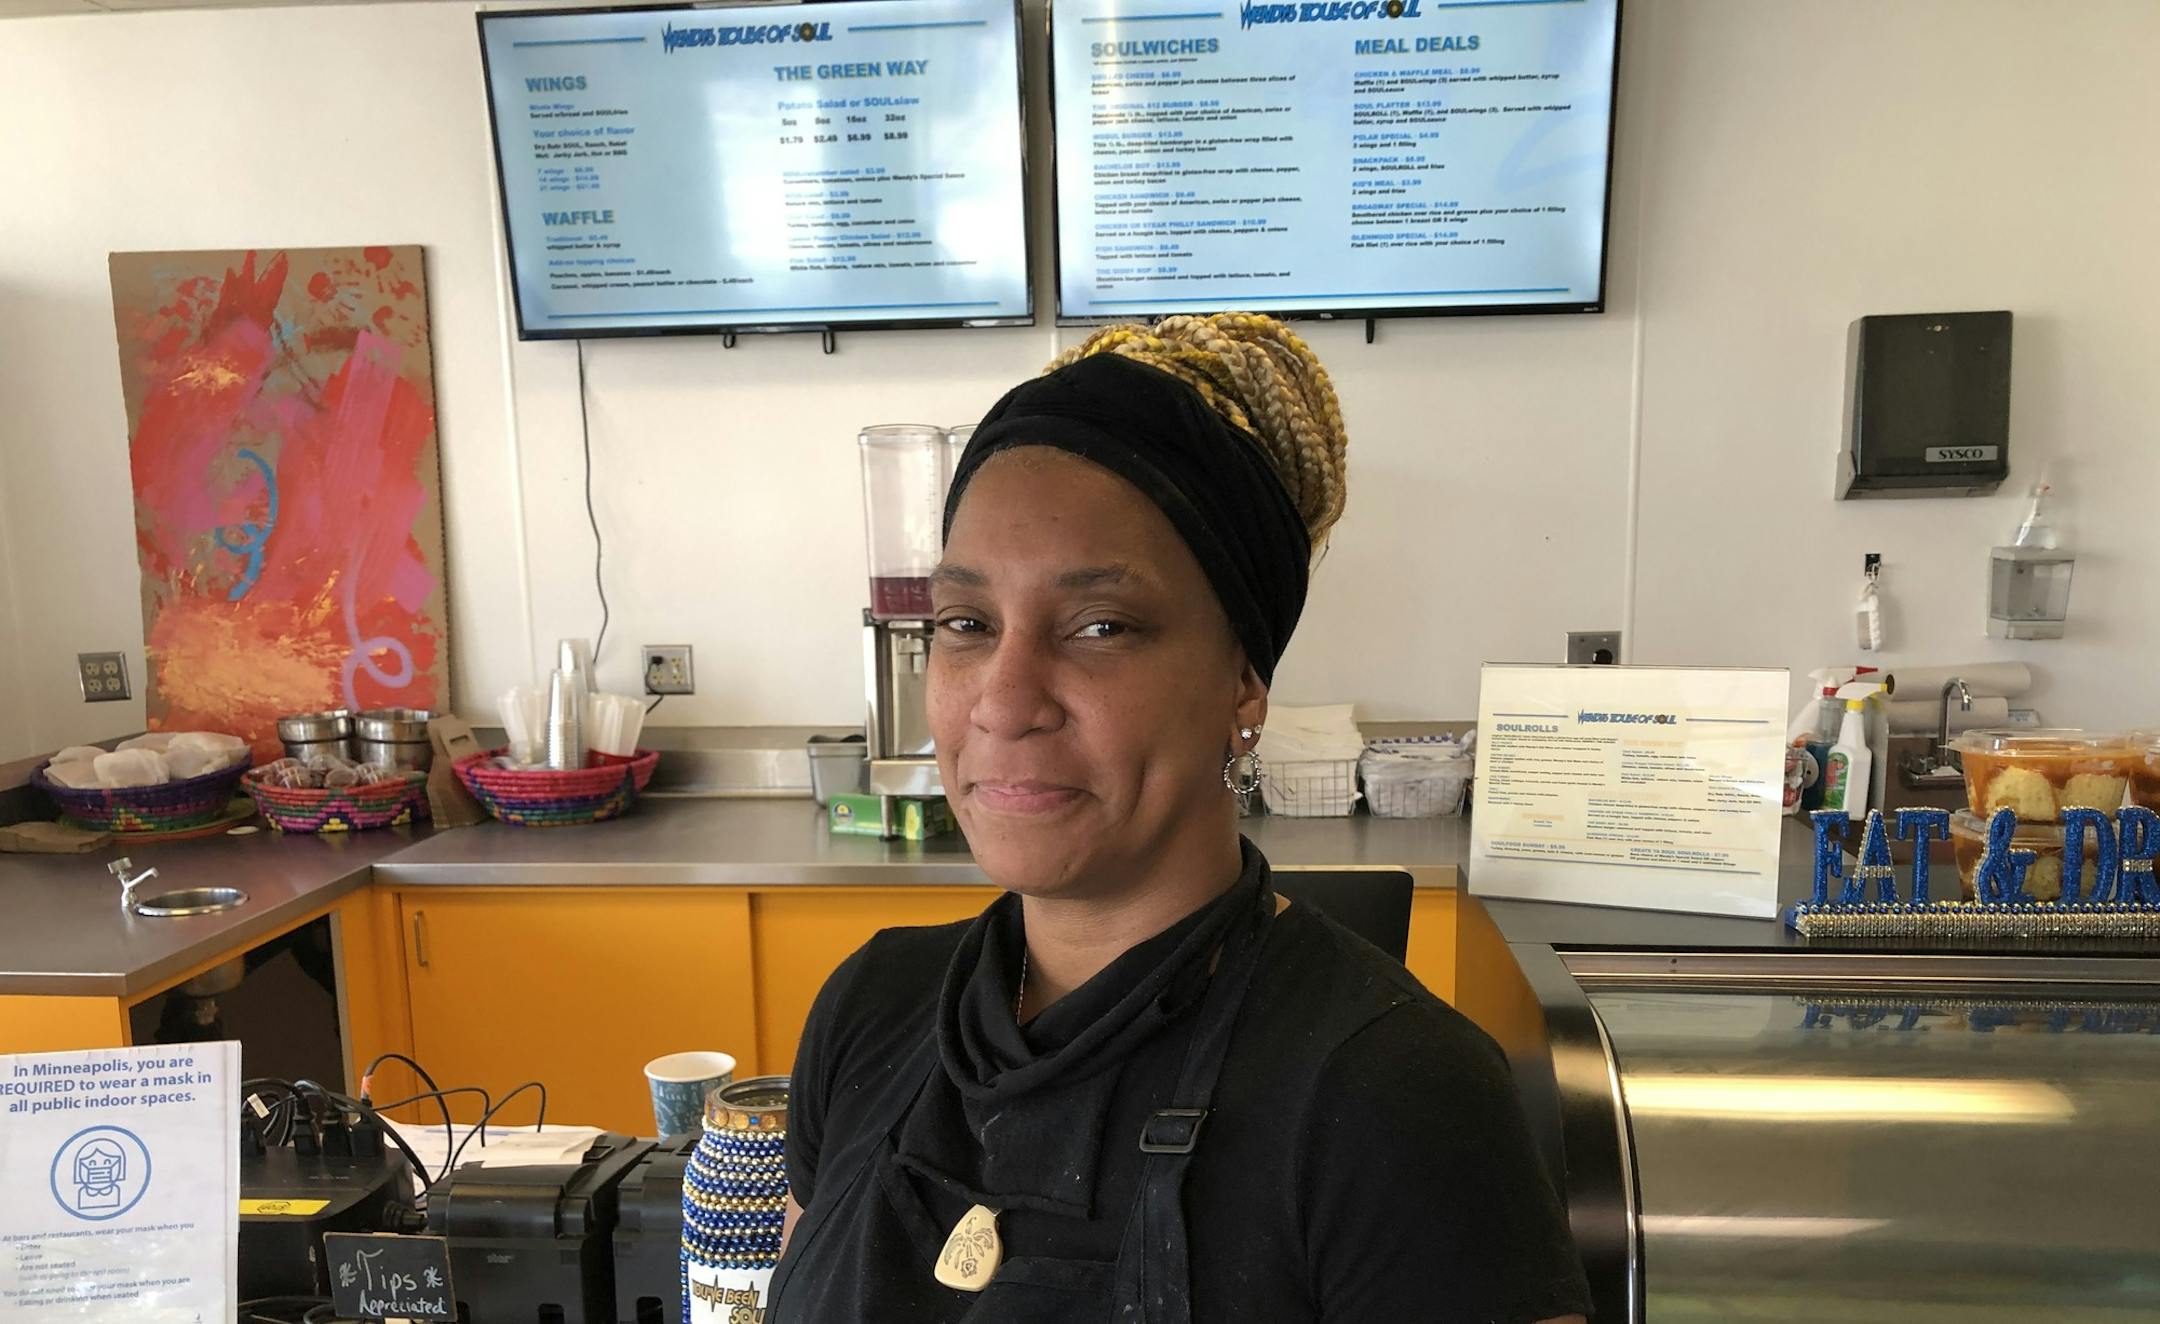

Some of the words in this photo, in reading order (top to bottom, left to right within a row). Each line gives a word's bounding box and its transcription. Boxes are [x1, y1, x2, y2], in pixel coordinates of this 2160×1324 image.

[1091, 38, 1219, 58] SOULWICHES
[1355, 38, 1410, 55] MEAL
[1415, 35, 1480, 52] DEALS
[773, 65, 812, 81] THE
[817, 62, 882, 80] GREEN
[886, 60, 929, 76] WAY
[525, 75, 587, 92] WINGS
[816, 98, 847, 109] Salad
[850, 99, 861, 108] or
[863, 97, 920, 107] SOULslaw
[533, 129, 556, 138] Your
[558, 128, 592, 138] choice
[594, 127, 604, 136] of
[606, 126, 635, 135] flavor
[542, 210, 614, 226] WAFFLE
[1939, 448, 1984, 459] SYSCO
[1496, 723, 1558, 733] SOULROLLS
[1809, 806, 1950, 904] EAT
[1973, 805, 2037, 905] &
[14, 1065, 28, 1077] In
[33, 1059, 133, 1076] Minneapolis,
[137, 1059, 165, 1073] you
[169, 1058, 194, 1068] are
[80, 1080, 96, 1091] to
[100, 1077, 137, 1090] wear
[140, 1076, 150, 1088] a
[153, 1072, 194, 1086] mask
[198, 1072, 212, 1084] in
[10, 1100, 28, 1113] all
[32, 1097, 81, 1115] public
[85, 1094, 137, 1108] indoor
[141, 1092, 196, 1107] spaces.
[48, 1230, 94, 1240] restaurants,
[116, 1228, 134, 1236] your
[135, 1224, 156, 1233] mask
[157, 1223, 179, 1232] when
[180, 1222, 194, 1230] you
[50, 1261, 76, 1270] seated
[356, 1248, 418, 1301] Tips
[117, 1280, 138, 1288] mask
[162, 1278, 176, 1287] you
[19, 1299, 44, 1308] Eating
[90, 1294, 112, 1302] when
[113, 1290, 140, 1299] seated
[359, 1289, 448, 1316] Appreciated
[725, 1280, 761, 1309] BEEN
